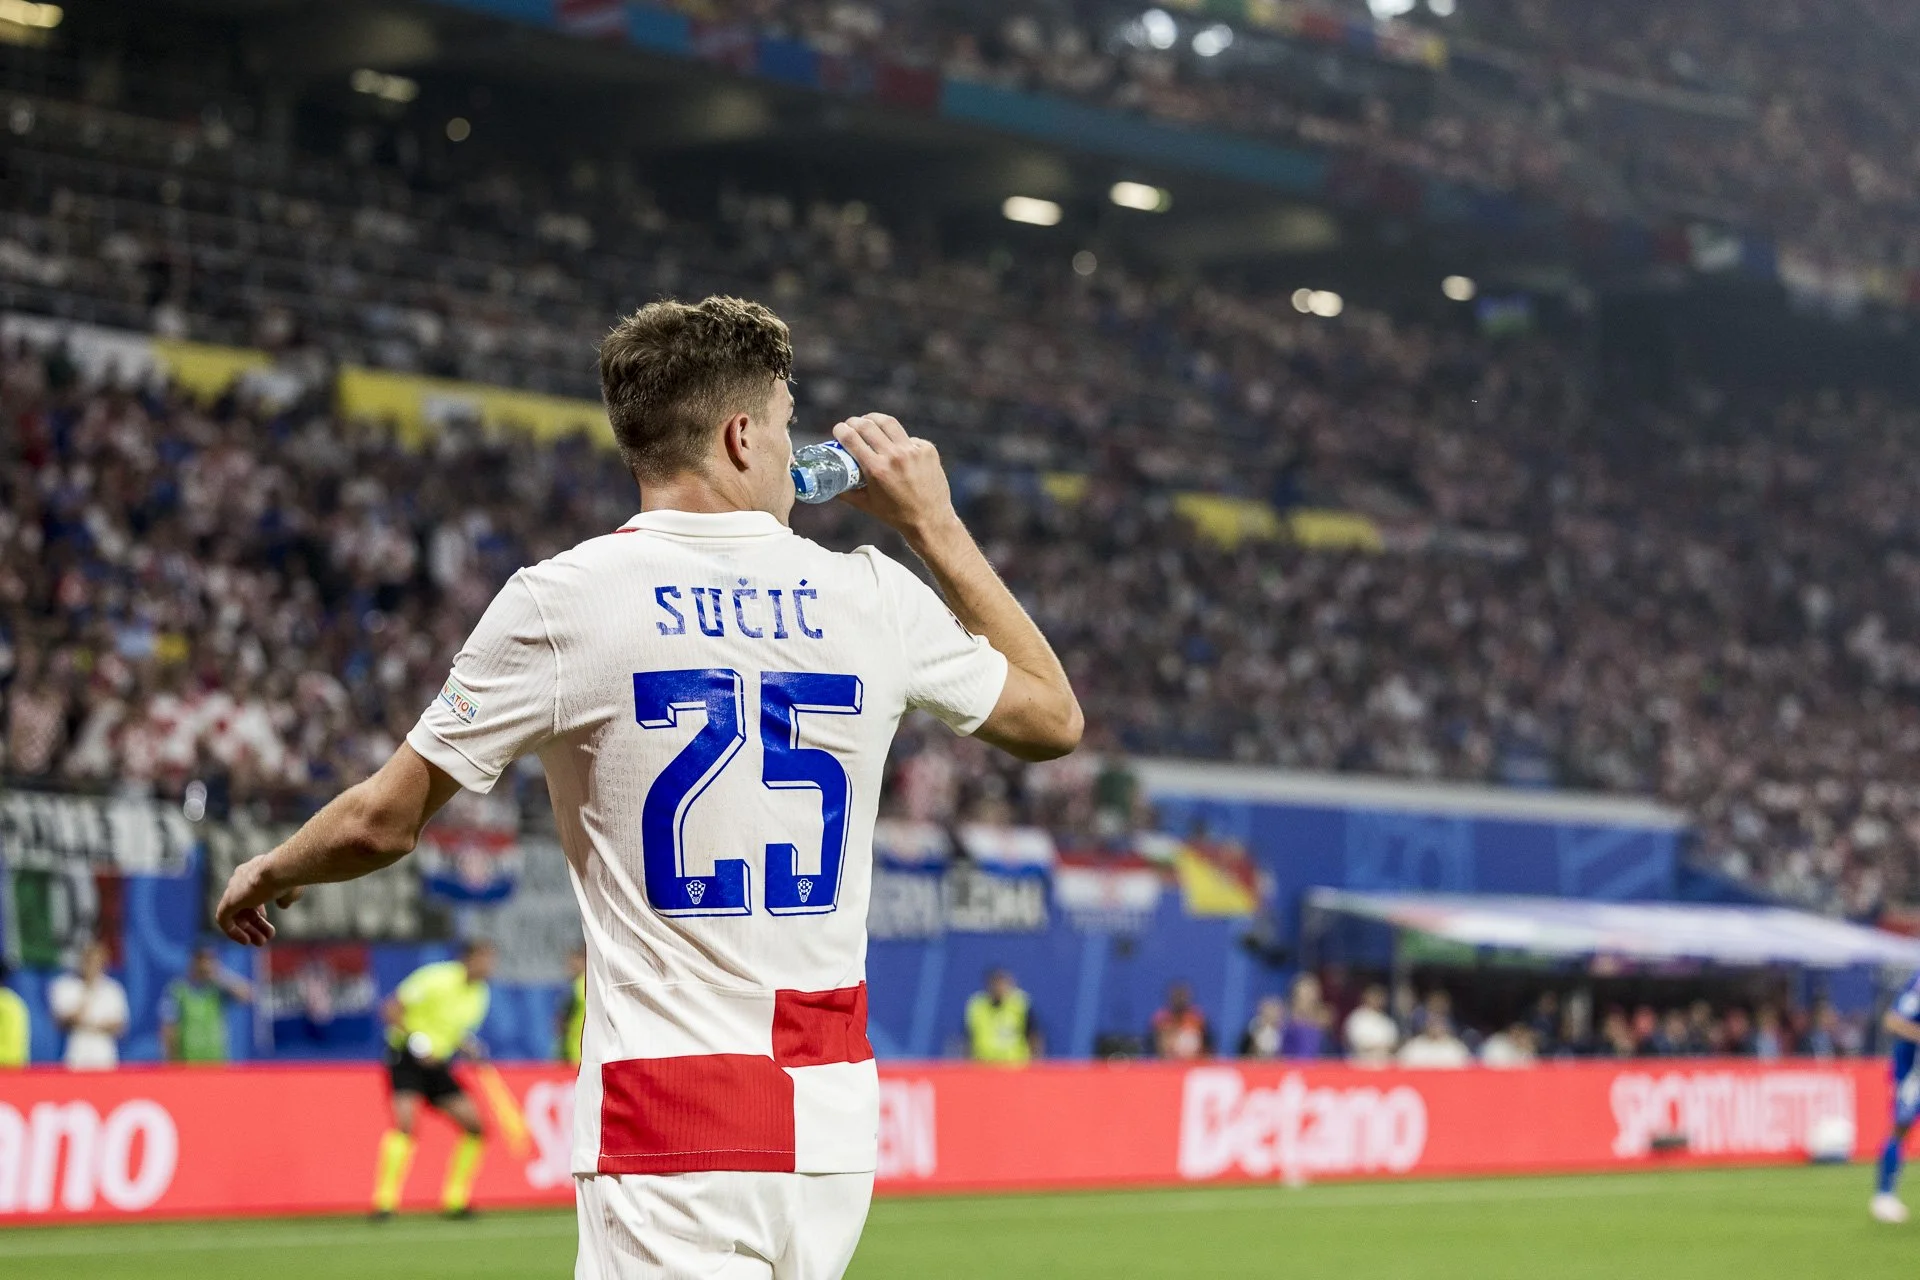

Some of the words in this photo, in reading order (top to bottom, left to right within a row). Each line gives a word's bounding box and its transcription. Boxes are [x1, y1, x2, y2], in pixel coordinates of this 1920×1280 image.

[655, 578, 823, 639] SUČIĆ
[632, 668, 864, 918] 25
[1177, 1066, 1428, 1178] Betano
